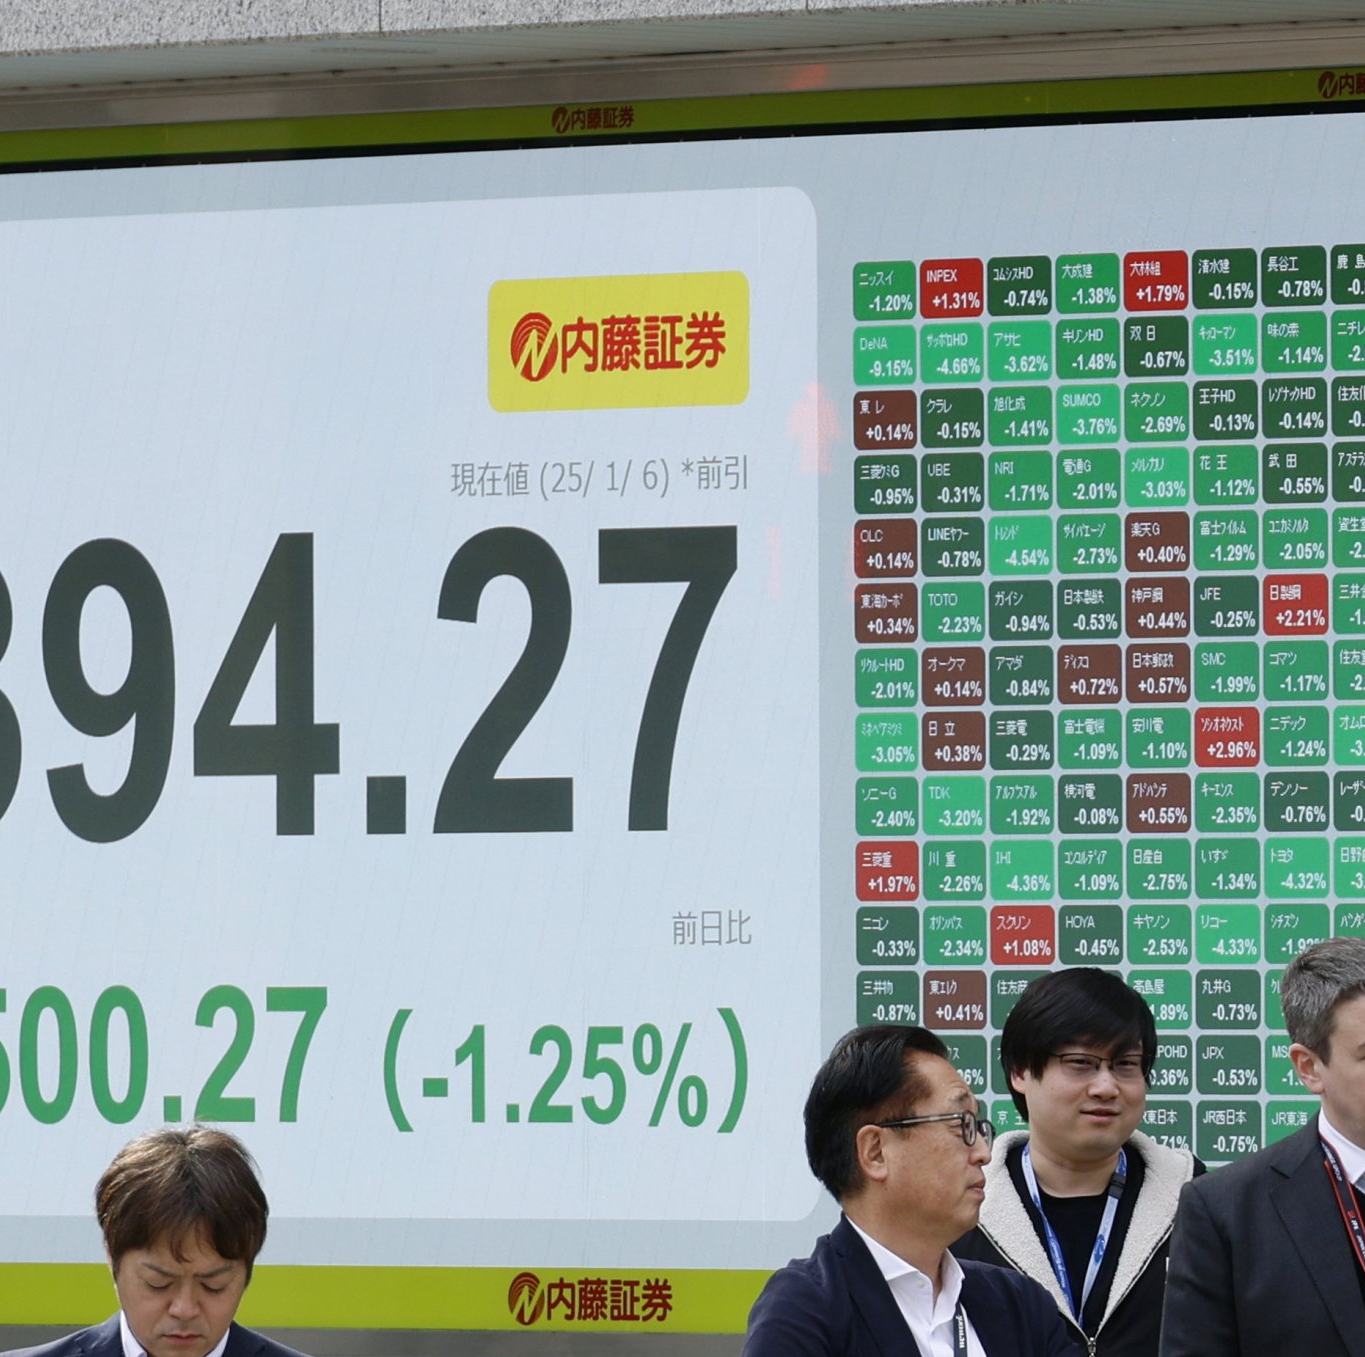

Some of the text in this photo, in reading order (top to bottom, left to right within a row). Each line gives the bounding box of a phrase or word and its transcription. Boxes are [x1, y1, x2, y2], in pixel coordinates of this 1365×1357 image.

[572, 106, 634, 129] 内藤証券
[1062, 264, 1093, 278] 大成建
[1130, 261, 1161, 276] 大林組
[1268, 256, 1299, 272] 長谷工
[927, 269, 957, 282] INPEX
[1072, 287, 1117, 304] -1.38%
[1136, 285, 1186, 302] +1.79%
[1278, 280, 1324, 297] -0.78%
[933, 292, 981, 309] +1.31%
[1268, 322, 1299, 337] 味の素
[562, 312, 725, 373] 内藤証券
[860, 337, 887, 350] DeNA
[1278, 347, 1325, 364] -1.14%
[869, 360, 914, 377] -9.15%
[1063, 393, 1101, 407] SUMCO
[1199, 388, 1235, 404] 王子HD
[1072, 418, 1118, 435] -3.76%
[1209, 414, 1255, 431] -0.13%
[928, 463, 950, 476] UBE
[995, 462, 1014, 474] NRI
[1063, 459, 1091, 475] 電通G
[451, 462, 529, 496] 現在値
[937, 486, 982, 503] -0.31%
[1004, 484, 1050, 501] -1.71%
[1073, 483, 1118, 500] -2.01%
[860, 529, 883, 542] OLC
[1131, 523, 1160, 537] 楽天G
[867, 552, 915, 569] +0.14%
[1138, 546, 1187, 563] +0.40%
[928, 593, 957, 606] TOTO
[1200, 587, 1221, 600] JFE
[938, 616, 983, 633] -2.23%
[1211, 611, 1257, 628] -0.25%
[1202, 652, 1225, 665] SMC
[1211, 676, 1257, 693] -1.99%
[996, 720, 1027, 736] 三菱電
[1132, 717, 1163, 734] 安川電
[1006, 744, 1051, 761] -0.29%
[1142, 742, 1188, 759] -1.10%
[929, 786, 949, 799] TDK
[939, 810, 983, 827] -3.20%
[996, 851, 1011, 864] IHI
[1134, 849, 1162, 864] 日産自
[1007, 875, 1051, 891] -4.36%
[1143, 874, 1189, 890] -2.75%
[673, 910, 751, 945] 前日比
[1066, 916, 1095, 928] HOYA
[1075, 939, 1120, 956] -0.45%
[1202, 1047, 1224, 1059] JPX
[384, 1008, 747, 1133] (-1.25%)
[1213, 1069, 1258, 1086] -0.53%
[547, 1278, 672, 1321] 内藤証券
